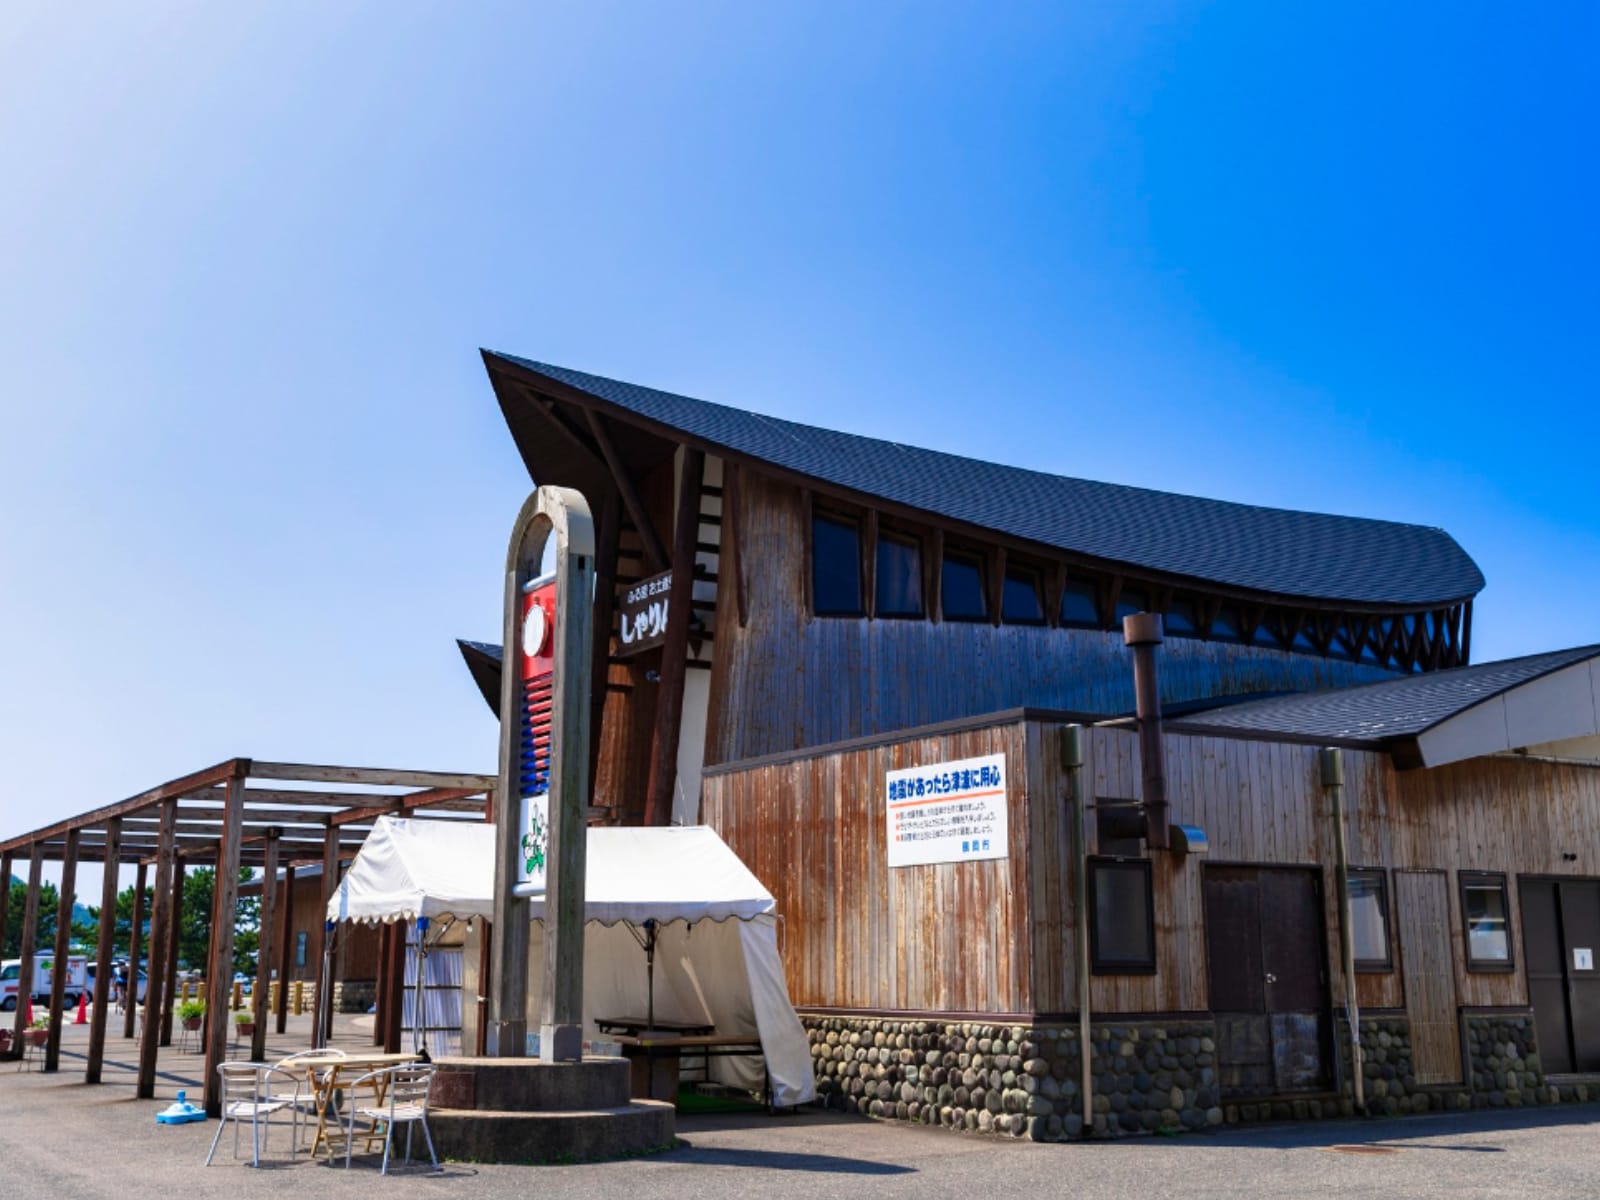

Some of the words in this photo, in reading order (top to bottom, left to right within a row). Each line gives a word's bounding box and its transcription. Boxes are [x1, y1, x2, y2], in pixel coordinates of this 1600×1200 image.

[889, 765, 1001, 801] 地震があったら津波に用心
